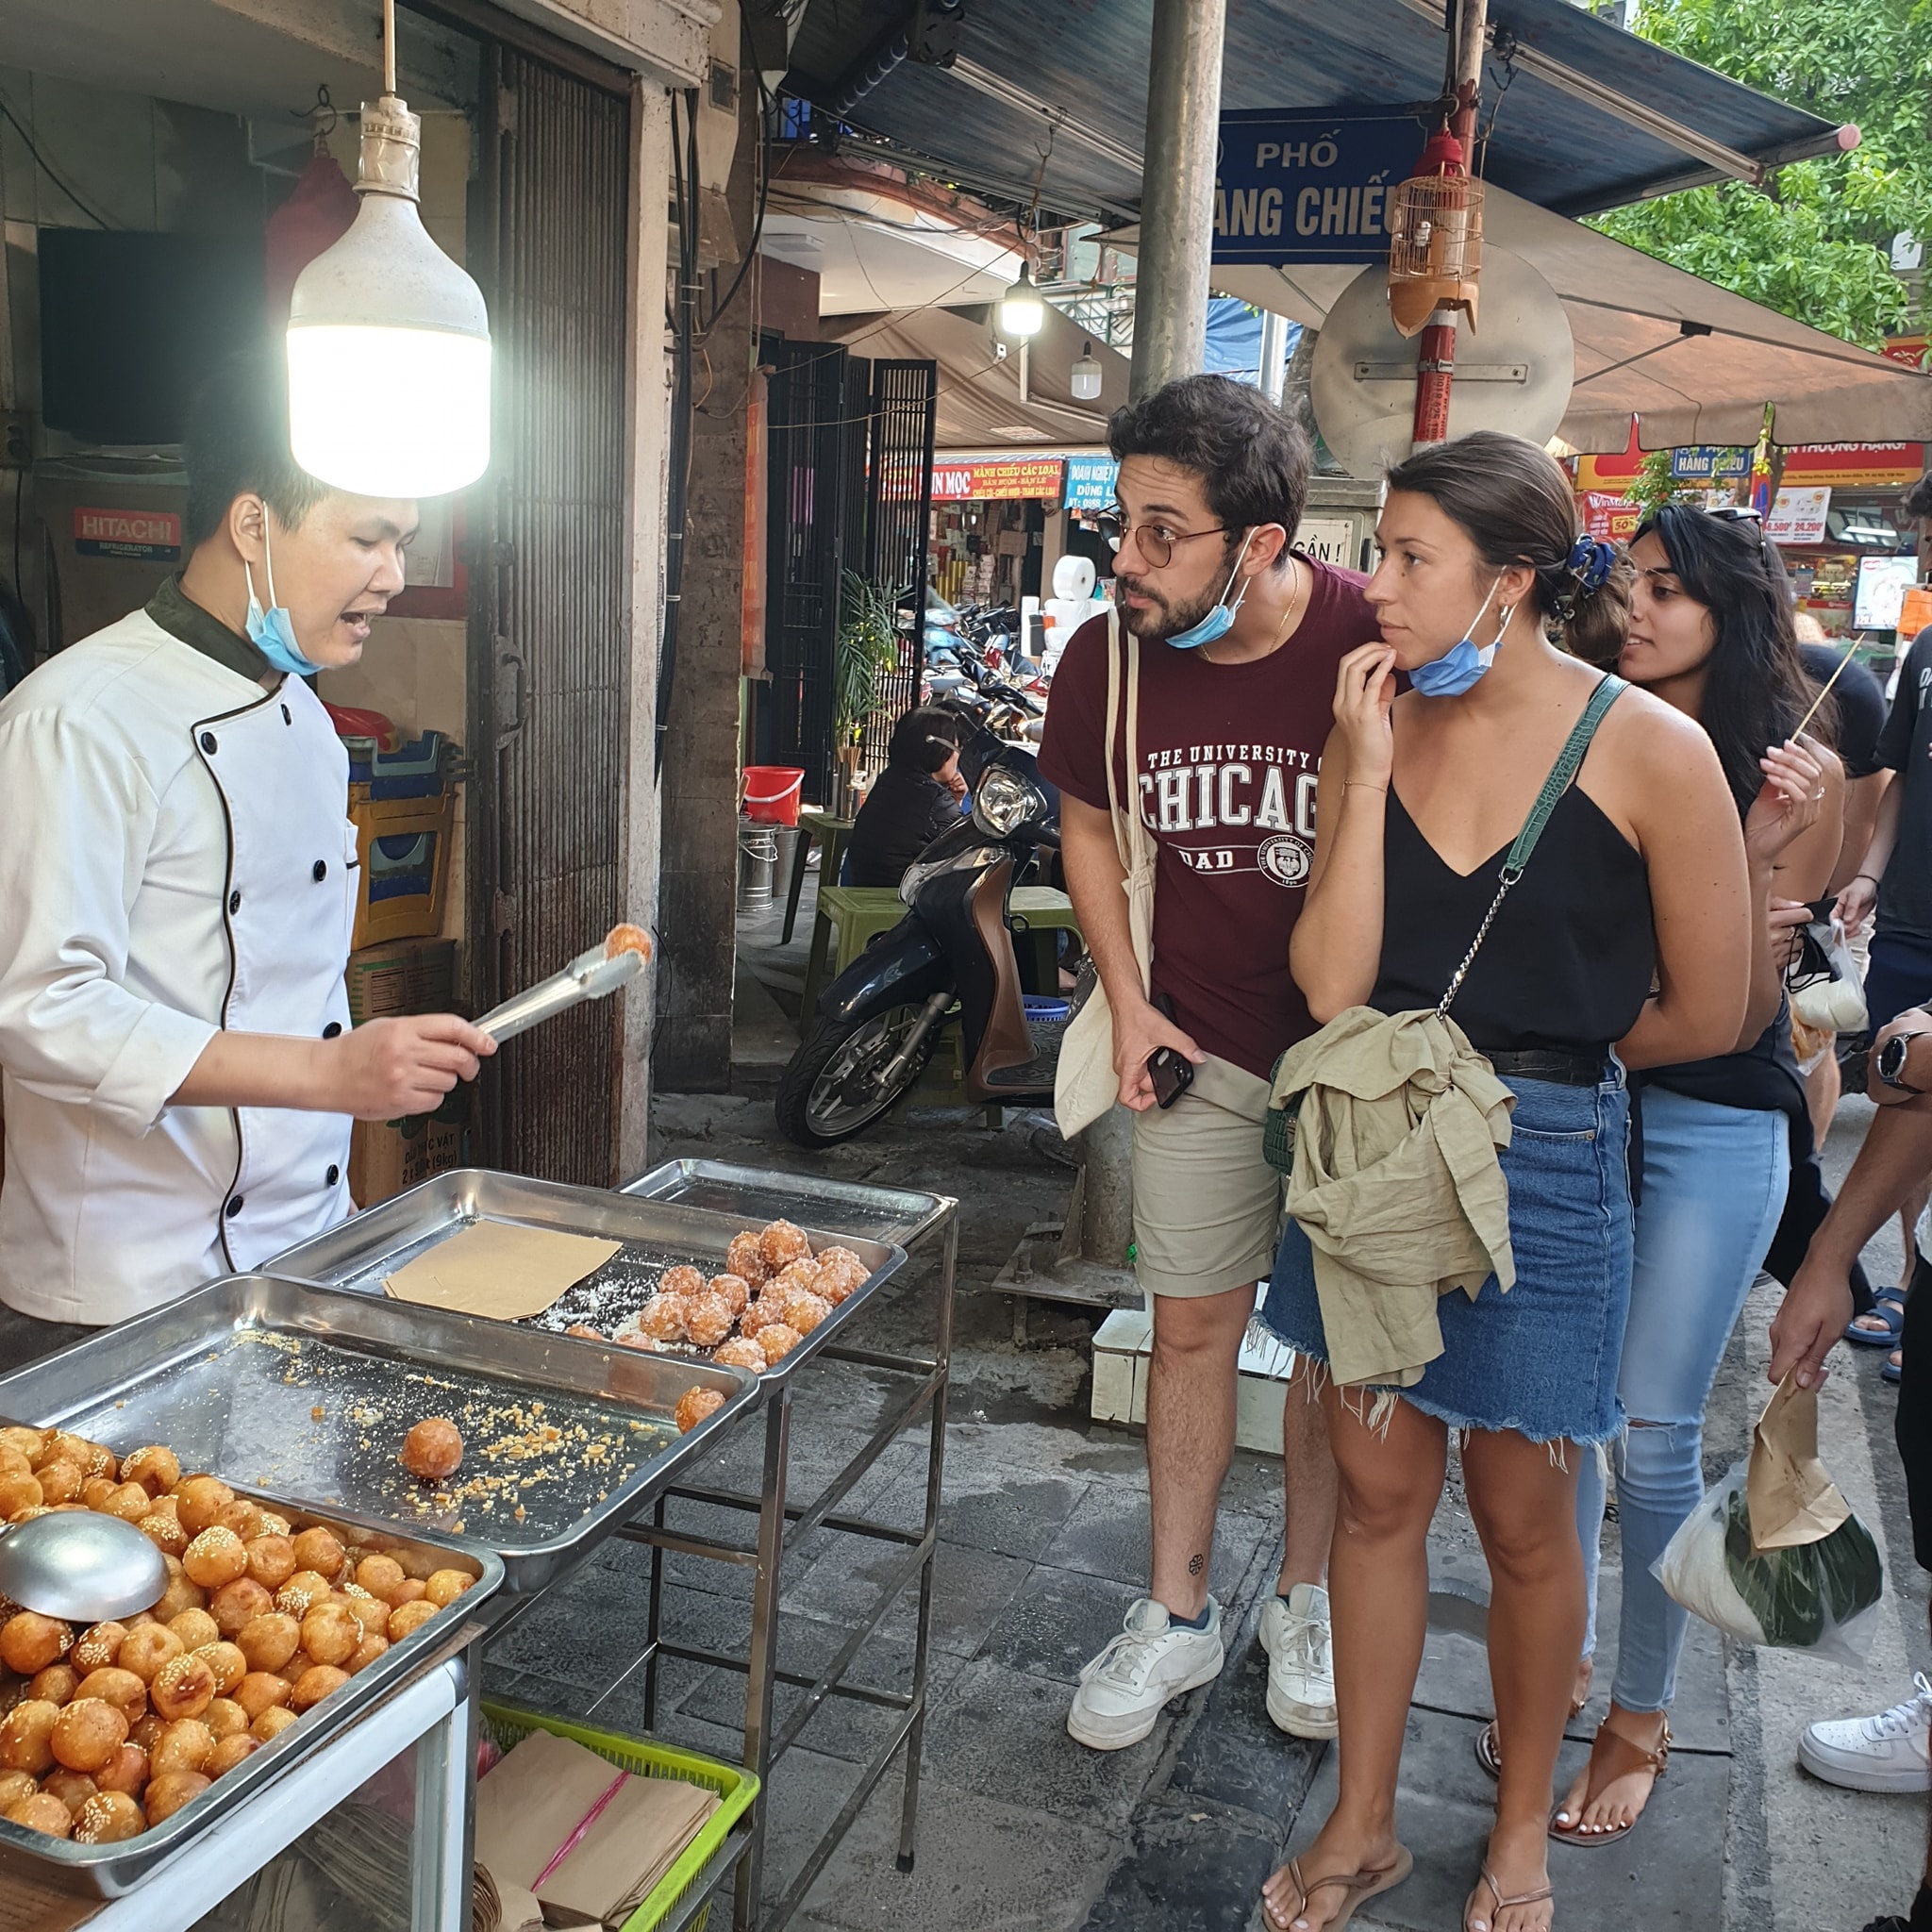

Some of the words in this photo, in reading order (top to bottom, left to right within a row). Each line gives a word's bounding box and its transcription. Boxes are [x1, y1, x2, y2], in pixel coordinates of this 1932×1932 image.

[1256, 128, 1341, 168] PHỐ
[1213, 176, 1284, 237] ÀNG
[1021, 463, 1038, 475] CÁC
[1678, 454, 1710, 472] HÀNG
[82, 515, 172, 541] HITACHI
[1147, 748, 1182, 769] THE
[1190, 744, 1310, 769] UNIVERSITY
[1138, 762, 1319, 840] CHICAG
[432, 1150, 457, 1169] (9kg)
